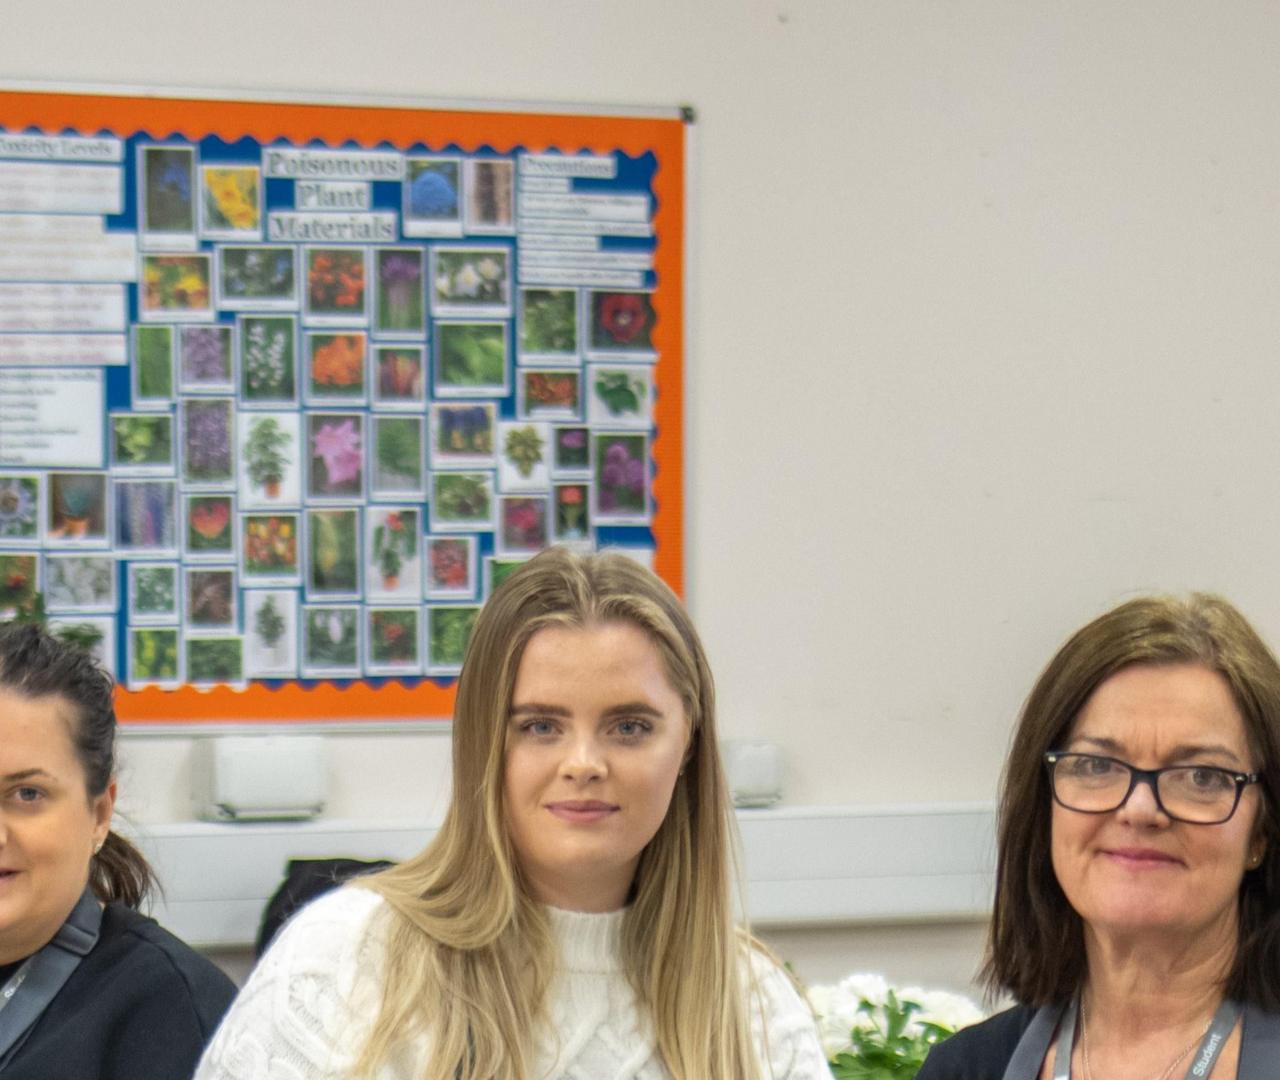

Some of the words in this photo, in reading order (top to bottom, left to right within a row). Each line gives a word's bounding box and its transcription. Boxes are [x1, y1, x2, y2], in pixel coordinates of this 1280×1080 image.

[61, 140, 112, 155] Levels
[269, 153, 400, 176] Poisonous
[299, 183, 366, 207] Plant
[272, 214, 396, 239] Materials
[1192, 1032, 1222, 1077] Student
